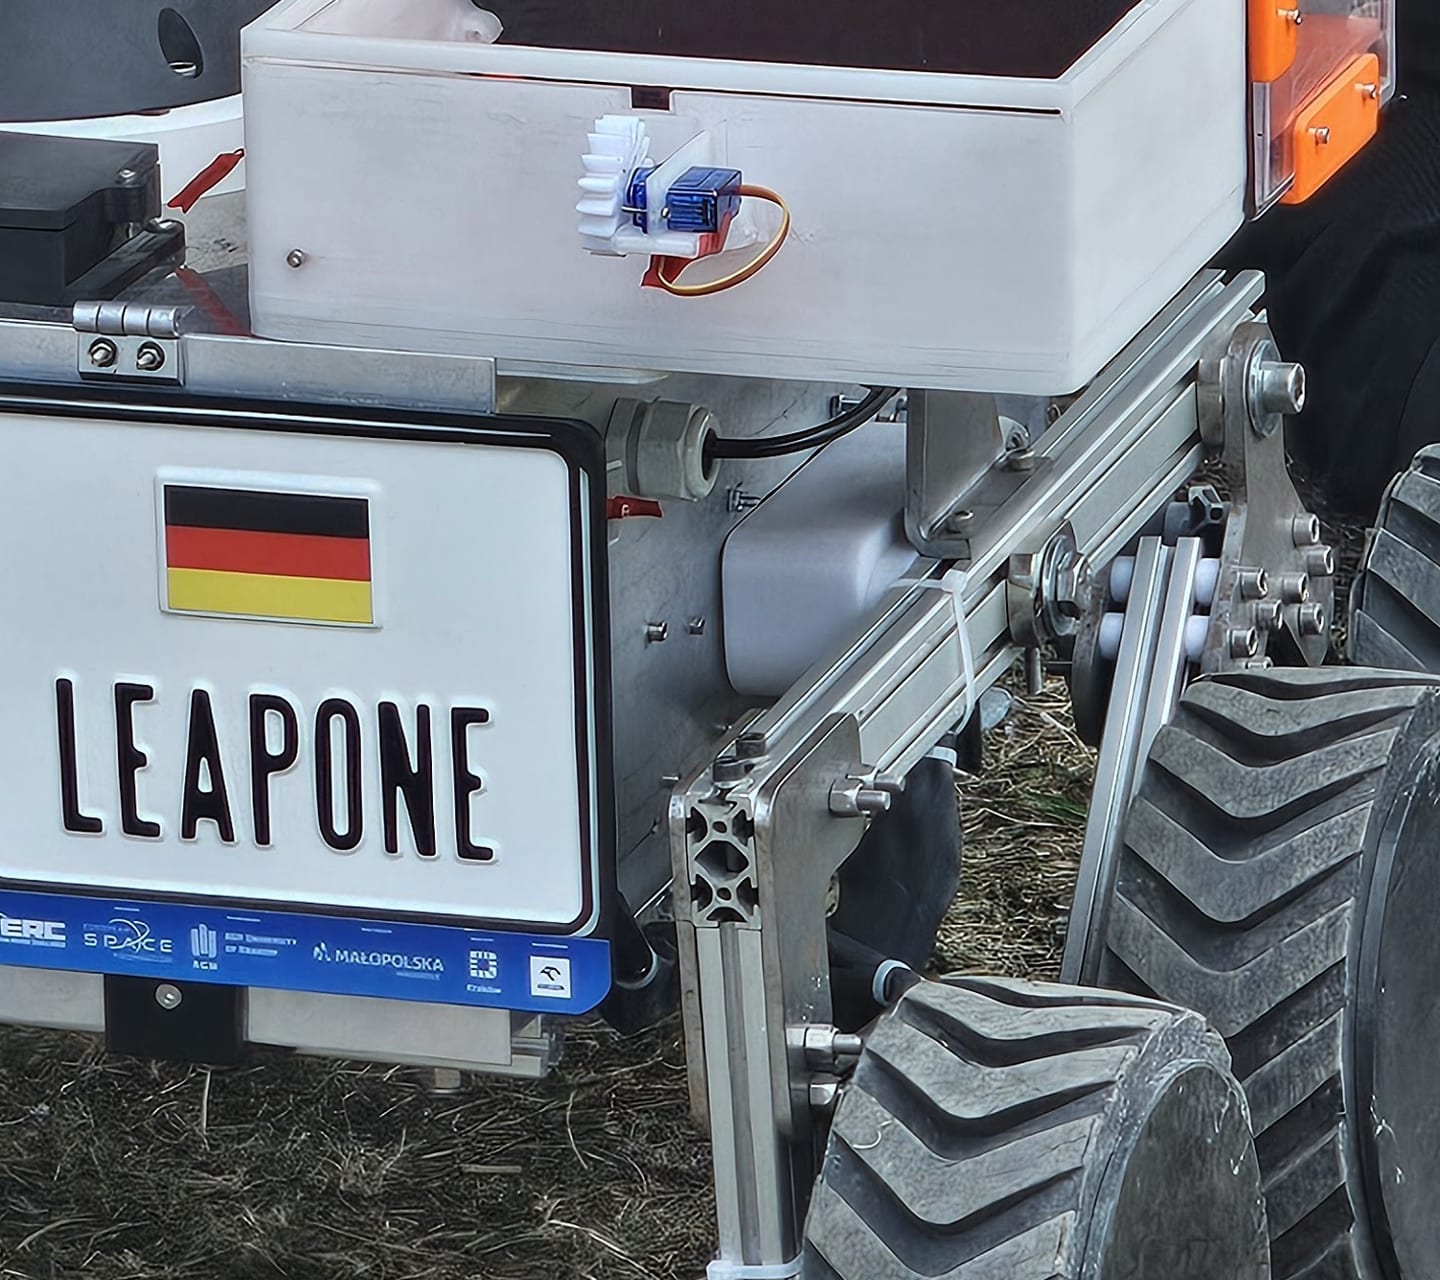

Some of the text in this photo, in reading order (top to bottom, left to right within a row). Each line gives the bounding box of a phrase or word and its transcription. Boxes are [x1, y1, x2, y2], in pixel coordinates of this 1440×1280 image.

[56, 678, 493, 861] LEAPONE
[0, 918, 66, 940] ERC
[83, 933, 173, 953] SPACE
[335, 950, 445, 973] MAŁOPOLSKA
